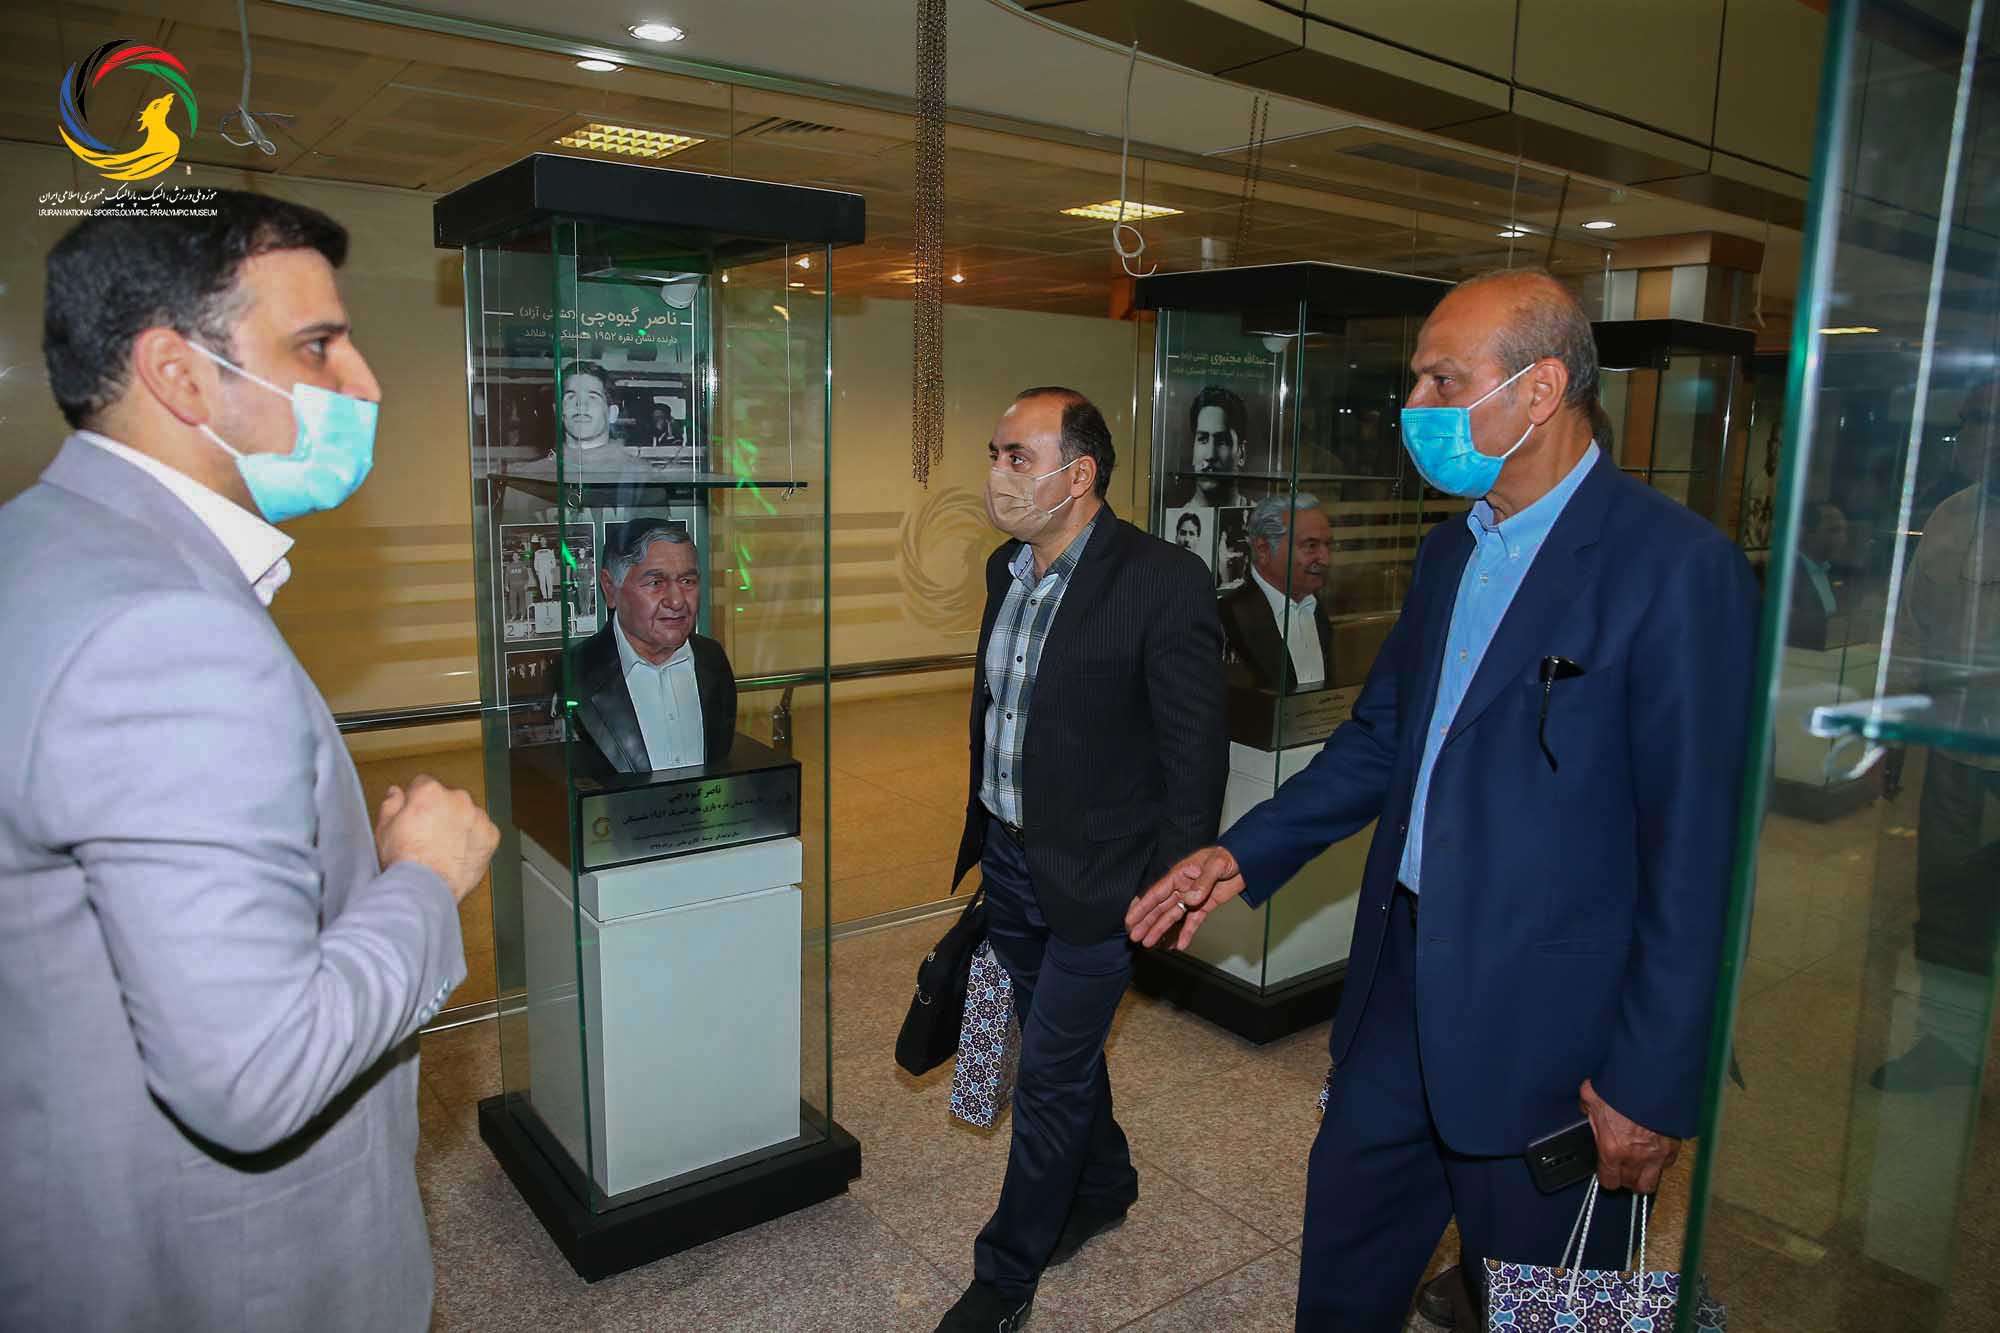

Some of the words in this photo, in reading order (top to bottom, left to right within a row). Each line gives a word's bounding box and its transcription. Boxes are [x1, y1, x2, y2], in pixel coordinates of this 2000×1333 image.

[644, 310, 677, 329] ناصر
[594, 330, 617, 341] ۱۹۵۲
[618, 332, 634, 344] نقره
[635, 334, 655, 345] نشان
